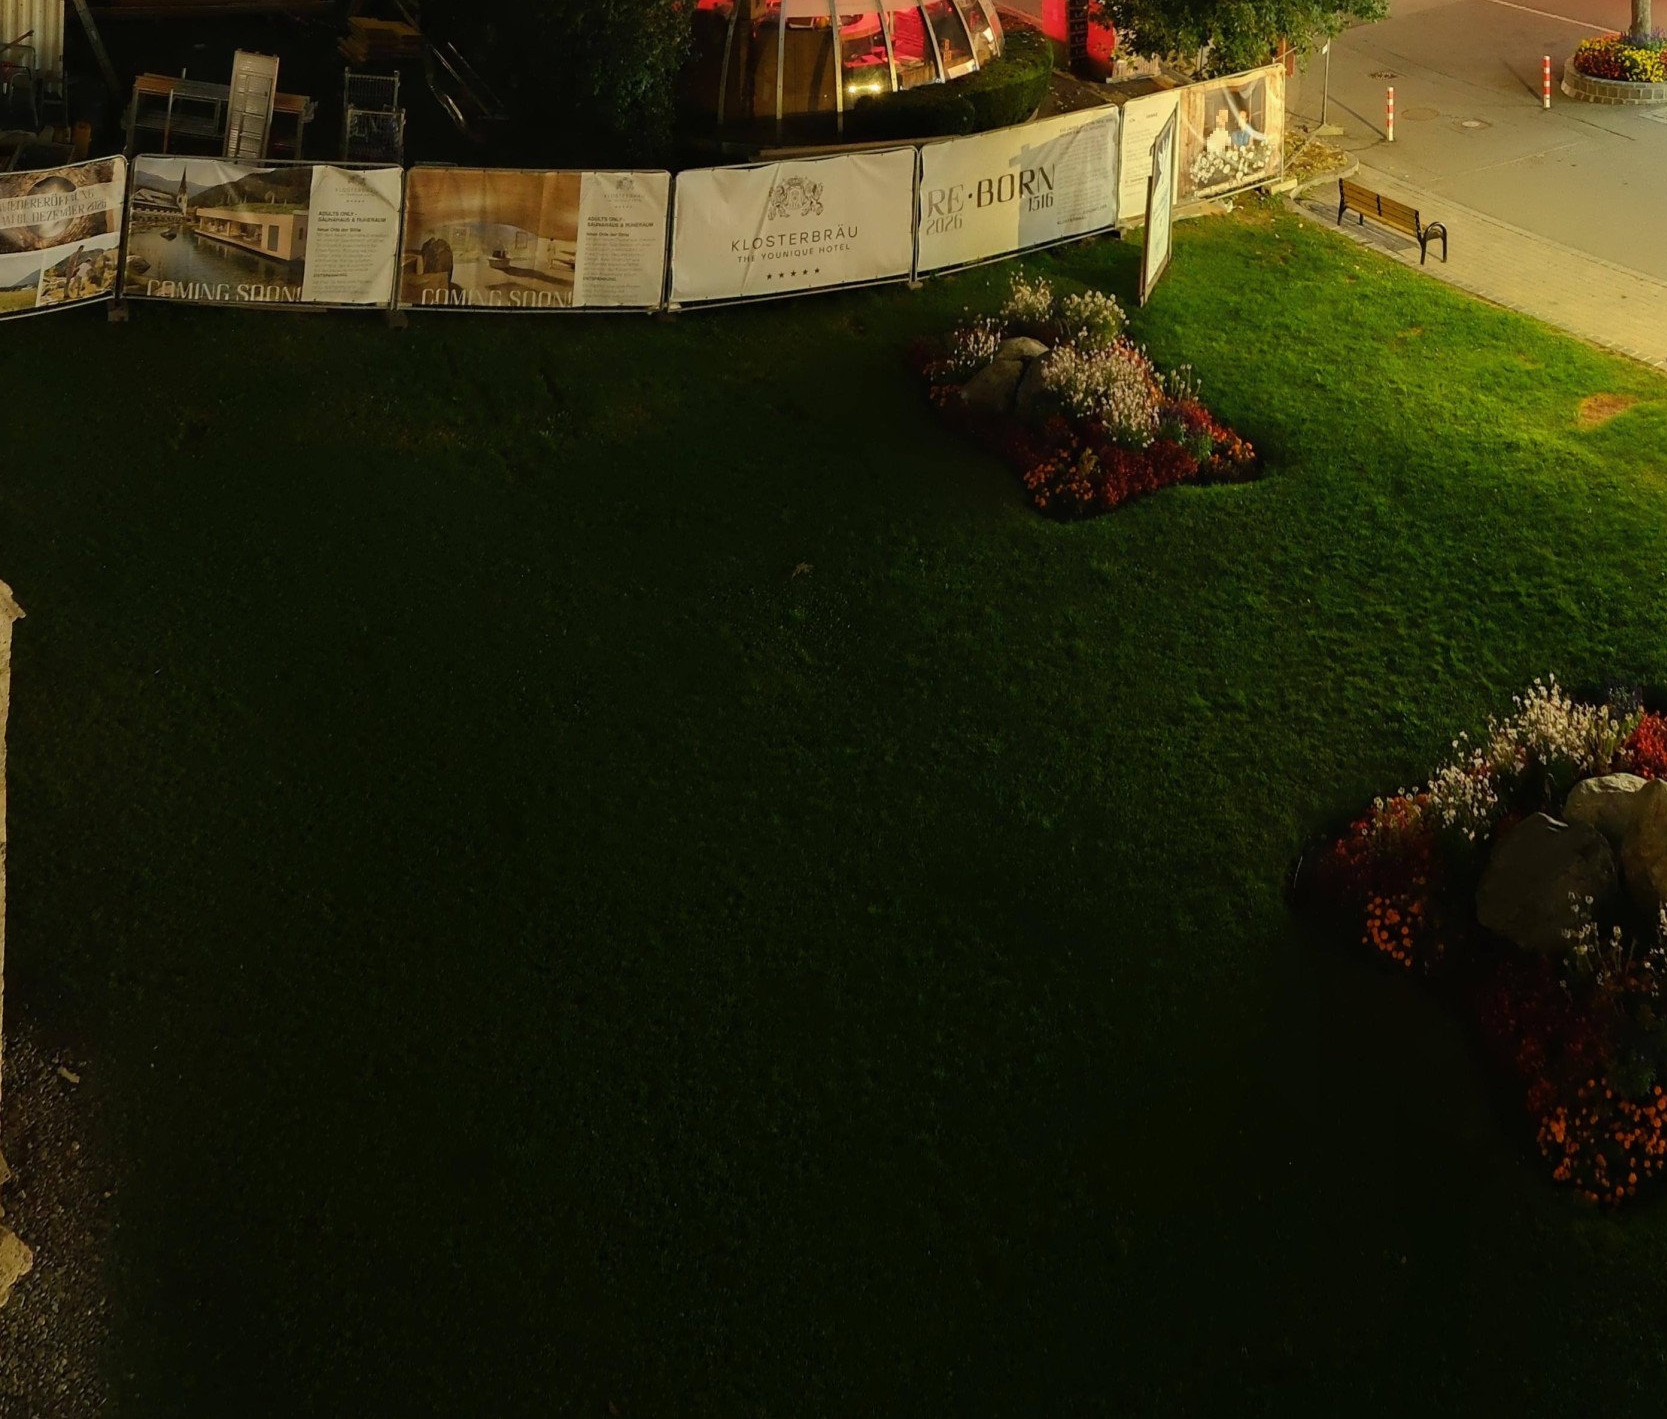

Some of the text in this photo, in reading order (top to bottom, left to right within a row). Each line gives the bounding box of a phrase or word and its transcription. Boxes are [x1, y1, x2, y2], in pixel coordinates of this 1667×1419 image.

[1028, 193, 1054, 212] 1516
[926, 214, 963, 236] 2026
[731, 223, 858, 252] KLOSTERBRÄU
[738, 243, 850, 263] THE YOUNIQUE HOTEL
